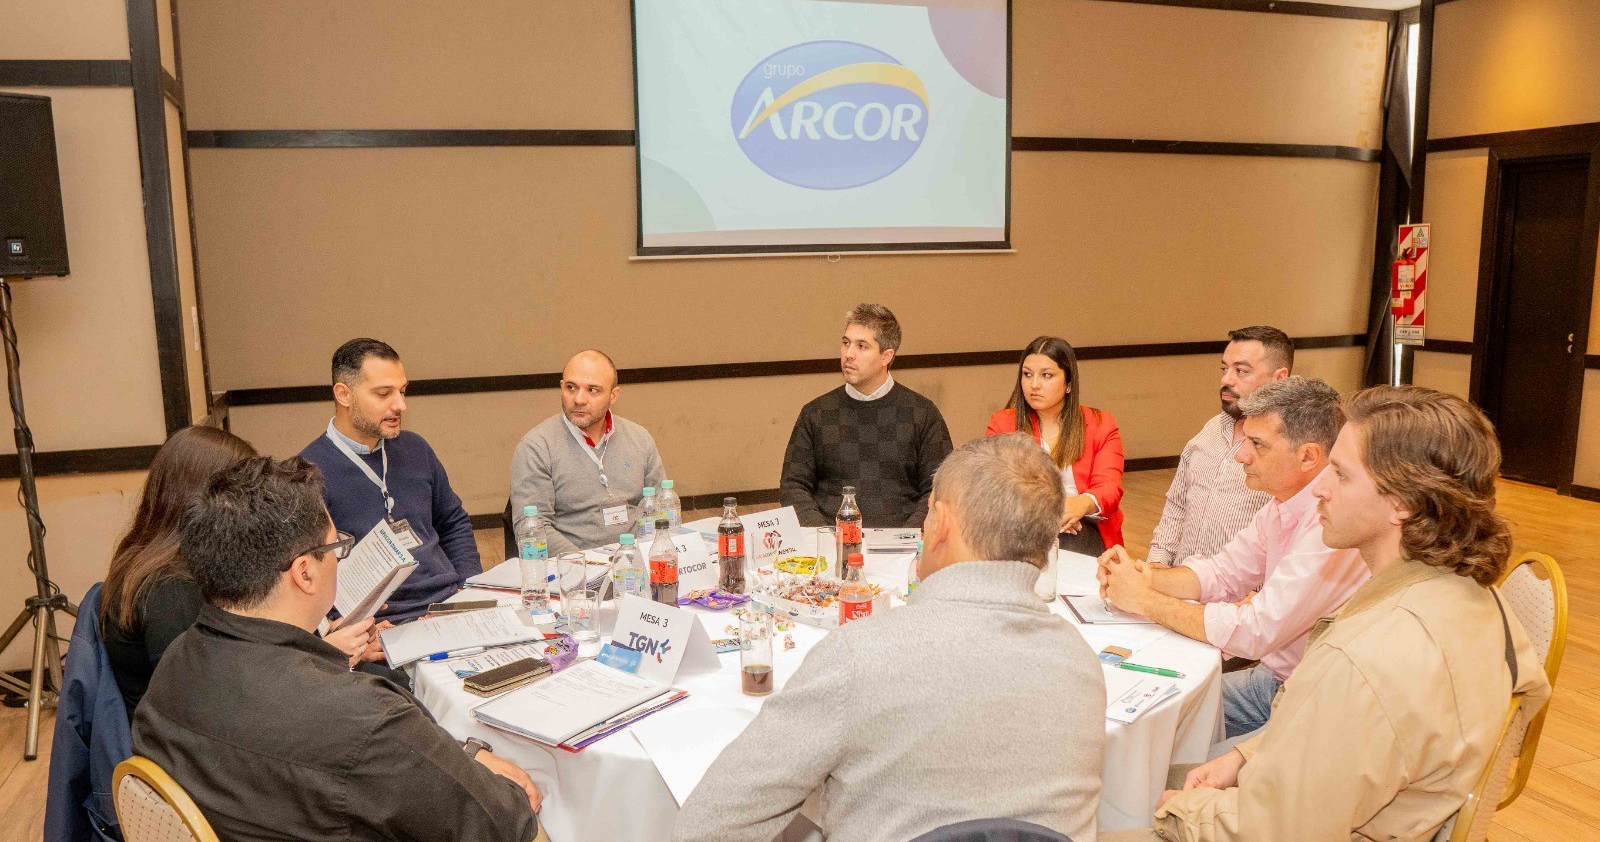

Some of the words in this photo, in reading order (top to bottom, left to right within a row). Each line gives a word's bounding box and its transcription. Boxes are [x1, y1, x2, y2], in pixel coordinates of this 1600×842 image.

[763, 62, 805, 79] grupo
[738, 86, 922, 142] ARCOR
[757, 519, 775, 529] MESA
[775, 517, 780, 526] 3
[681, 544, 687, 553] 3
[678, 562, 708, 576] RTOCOR
[639, 611, 660, 626] MESA
[662, 618, 669, 628] 3
[628, 631, 660, 656] TGN
